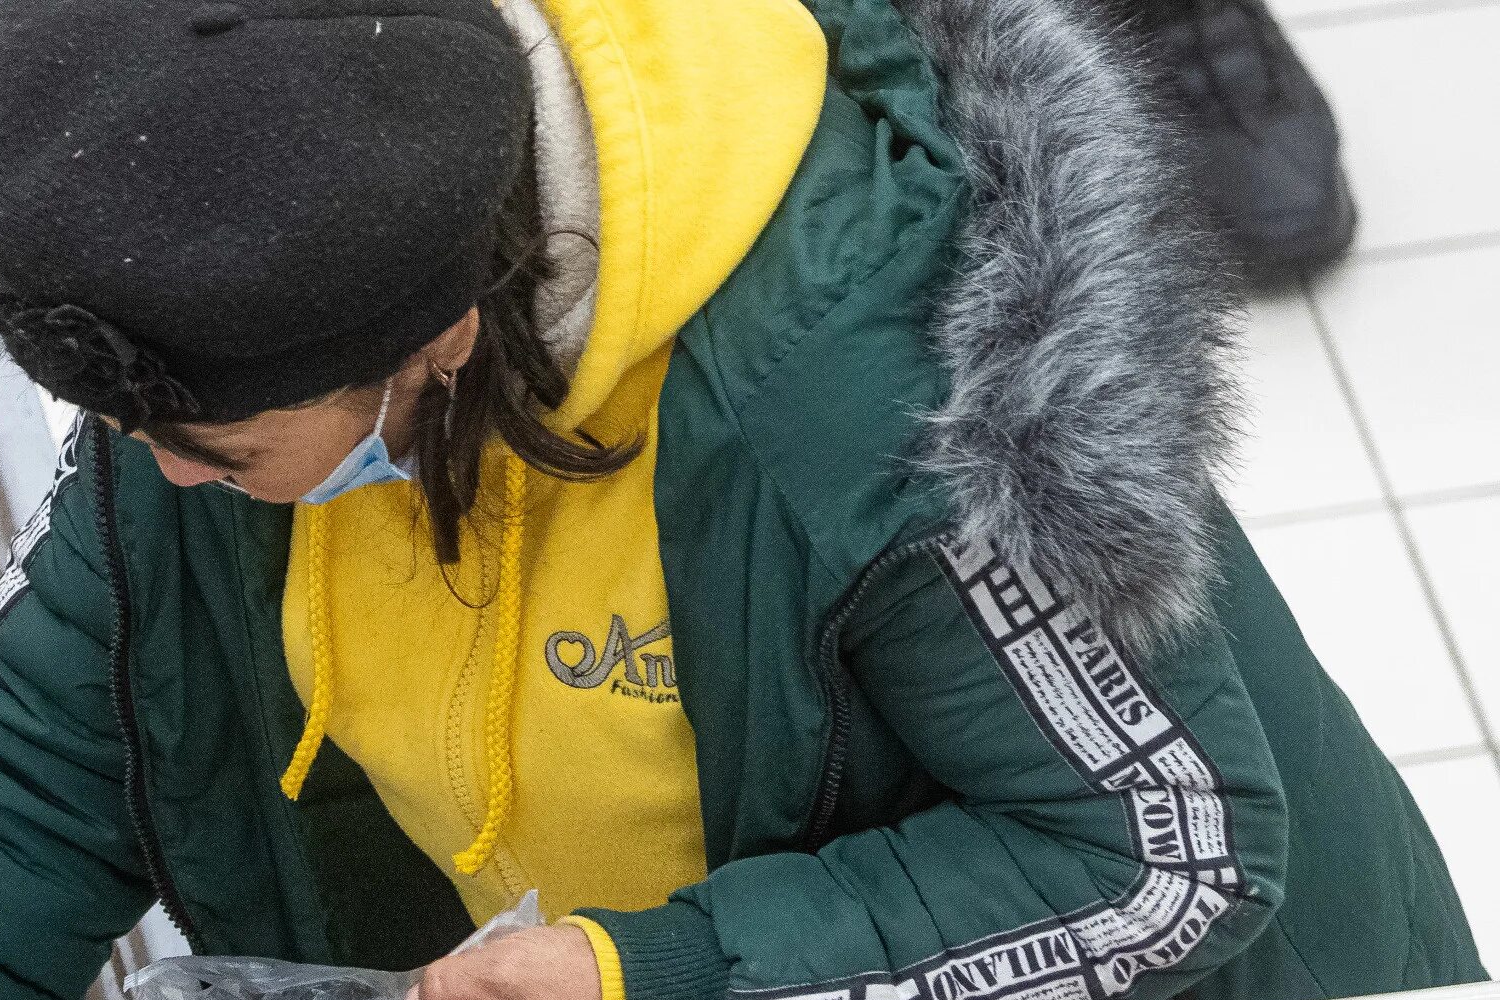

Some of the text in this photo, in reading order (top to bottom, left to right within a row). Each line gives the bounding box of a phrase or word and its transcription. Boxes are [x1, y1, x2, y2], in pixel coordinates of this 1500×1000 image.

[545, 614, 677, 689] An
[1063, 616, 1154, 727] PARIS
[1113, 893, 1223, 985] TOKYO
